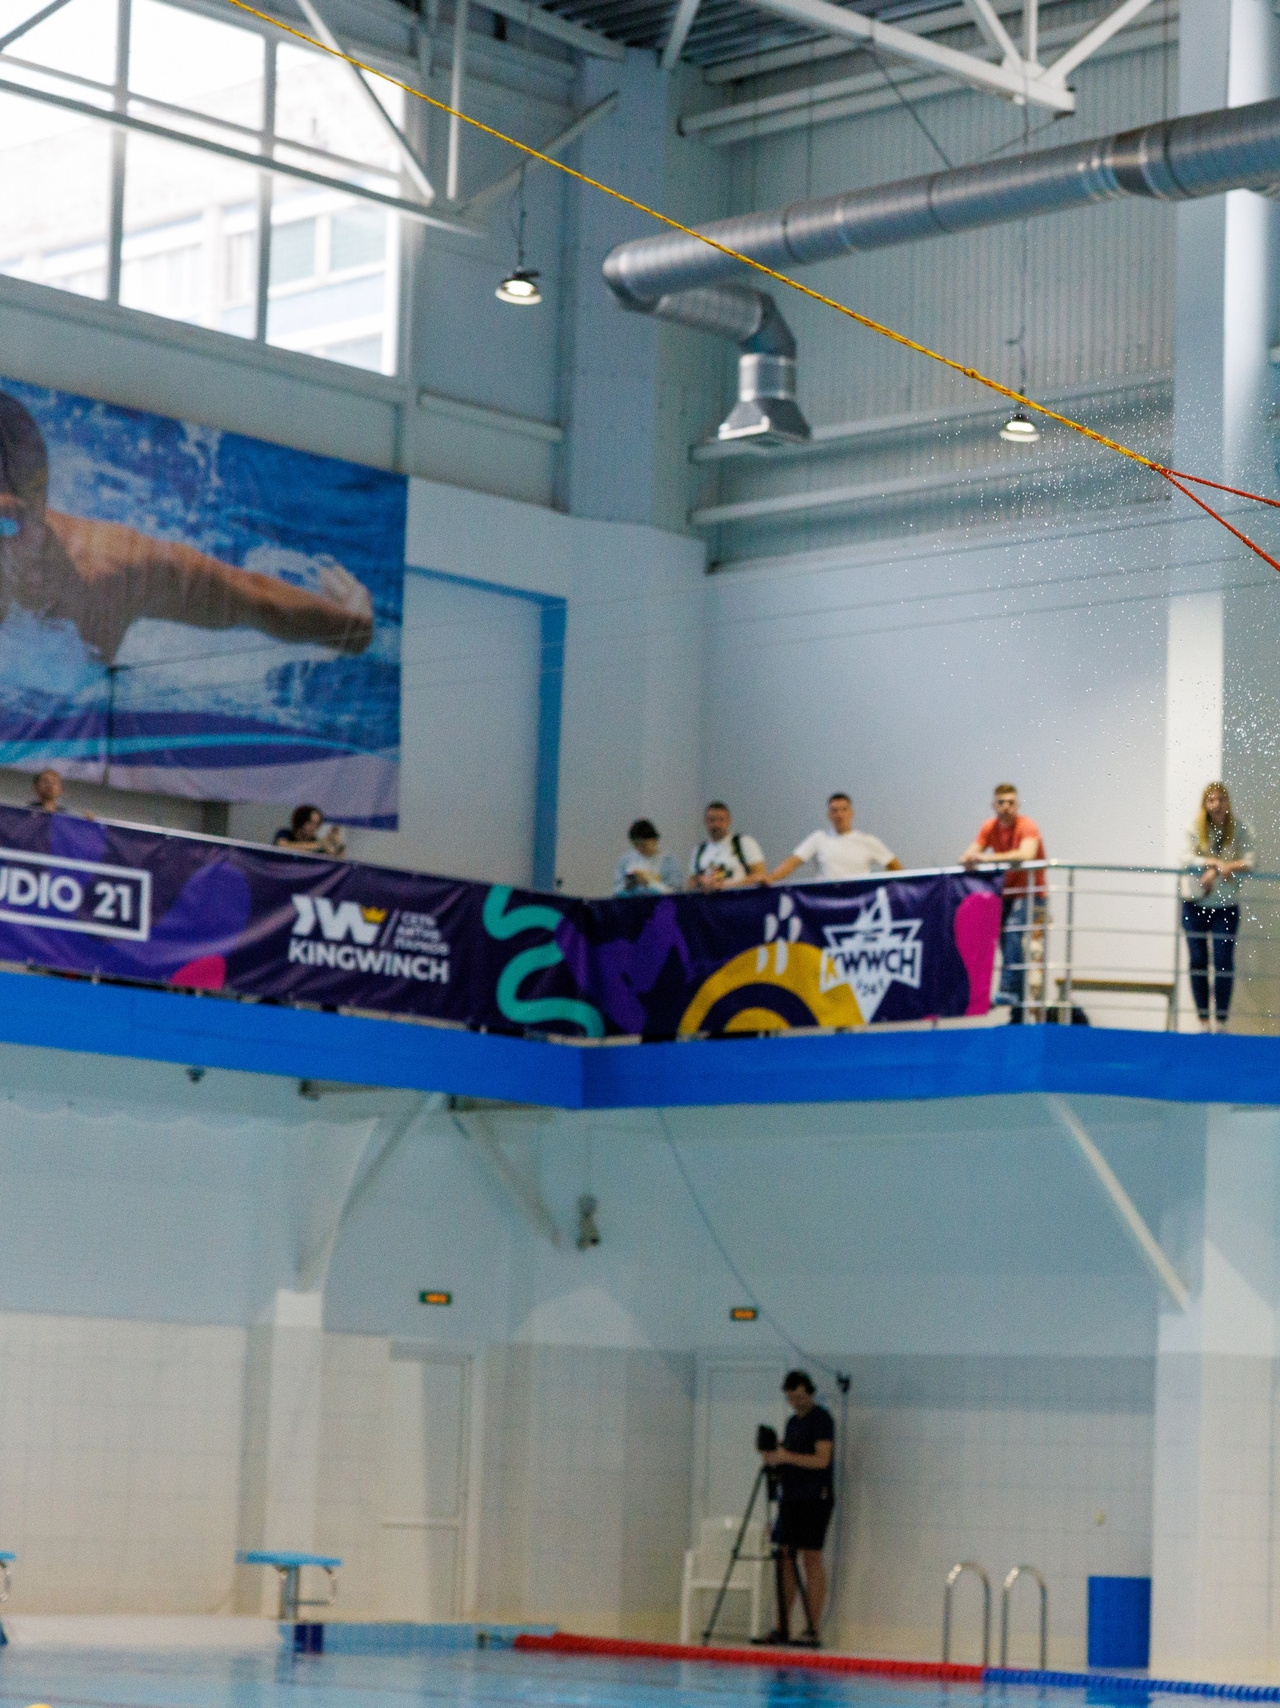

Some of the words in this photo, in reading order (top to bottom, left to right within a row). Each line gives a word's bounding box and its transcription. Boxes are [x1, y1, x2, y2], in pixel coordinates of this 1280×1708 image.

[93, 881, 132, 922] 21
[288, 937, 450, 984] KINGWINCH
[823, 946, 917, 983] KWWCH
